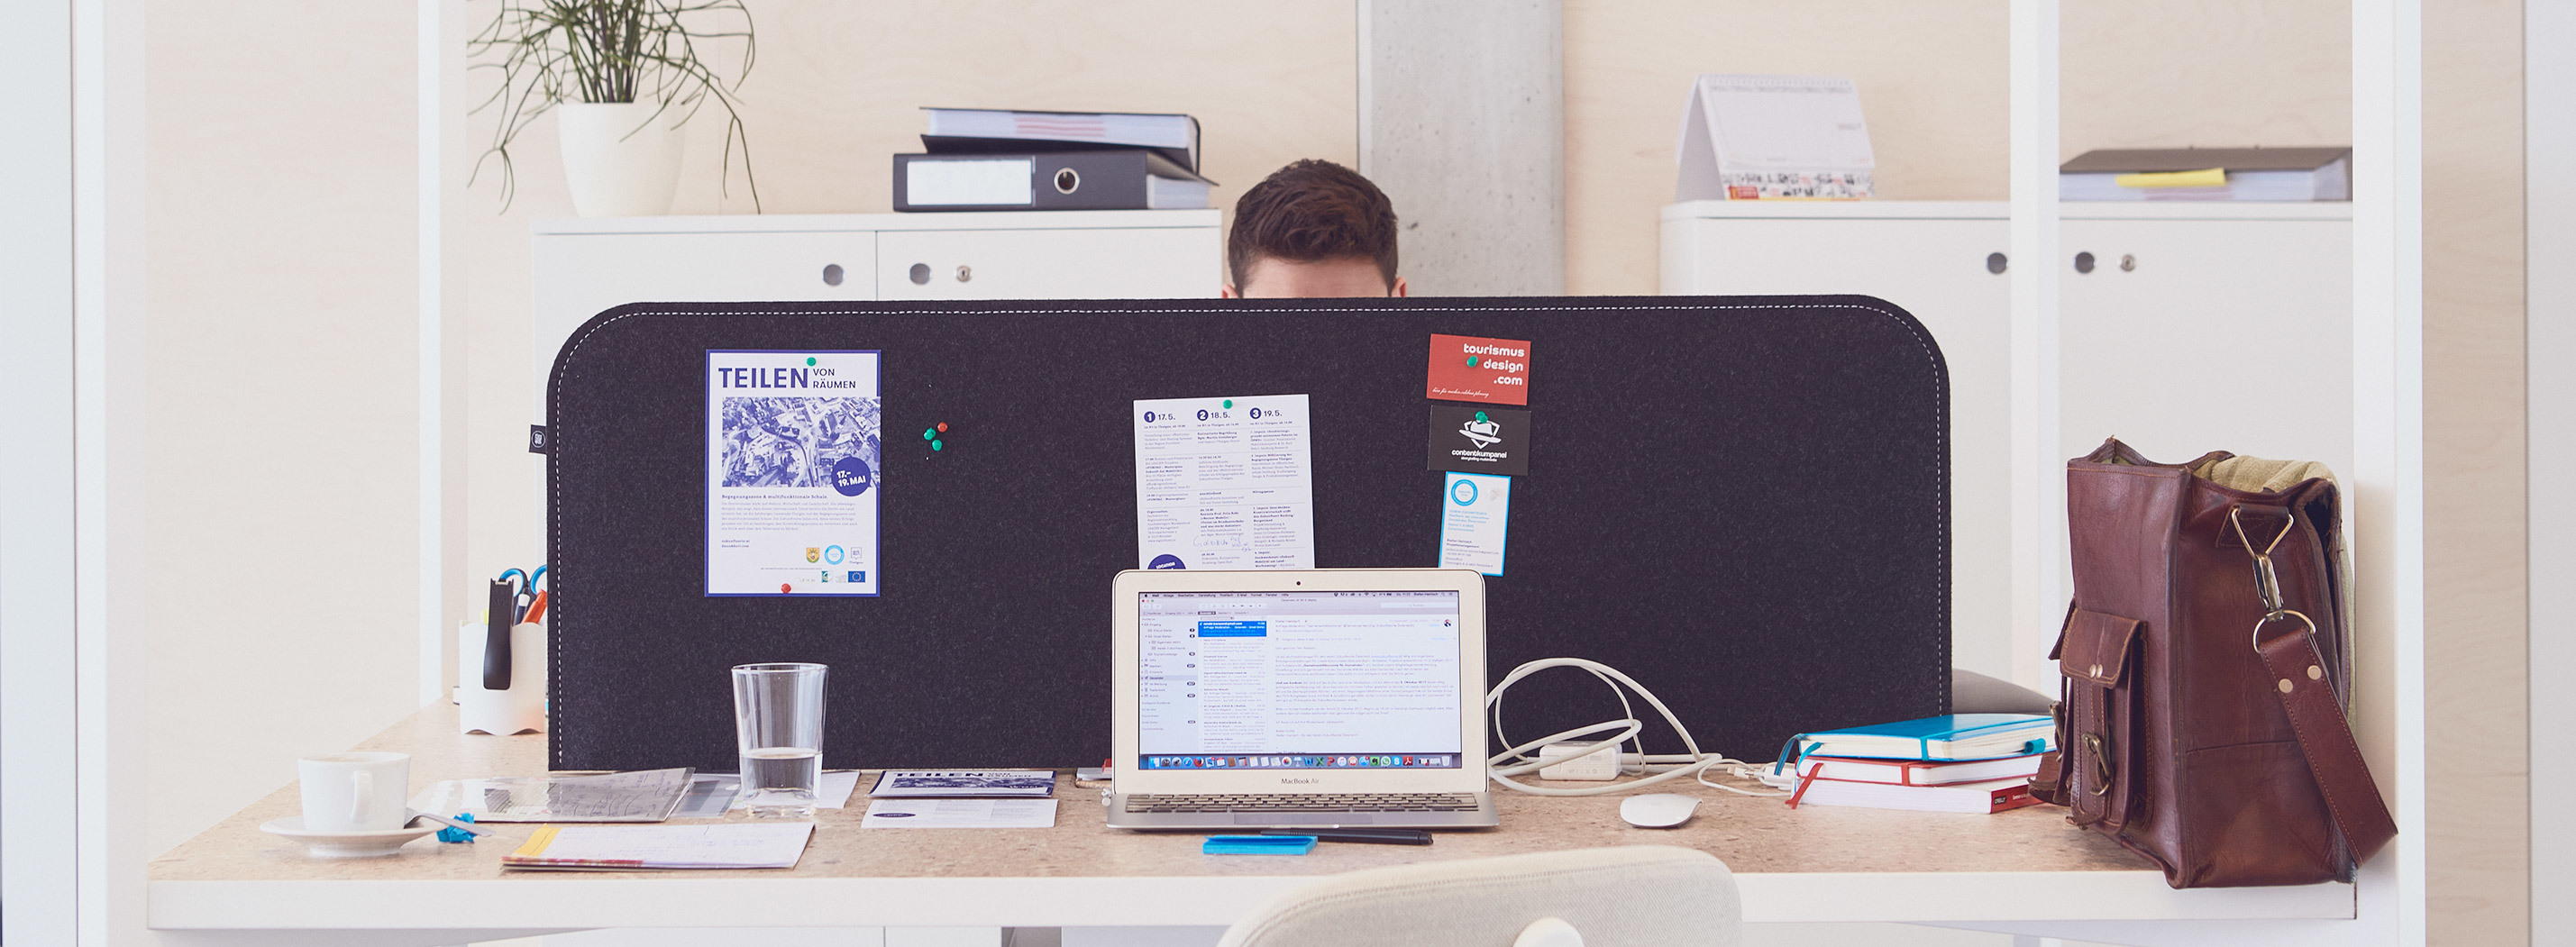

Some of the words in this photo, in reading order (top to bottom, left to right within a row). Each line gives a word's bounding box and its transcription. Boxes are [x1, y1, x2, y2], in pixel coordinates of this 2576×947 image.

[1464, 343, 1525, 357] tourismus
[1483, 359, 1523, 373] design
[718, 368, 808, 388] TEILEN
[813, 368, 835, 377] VON
[813, 378, 855, 389] RÄUMEN
[1494, 376, 1522, 386] .com
[849, 475, 866, 486] MAI
